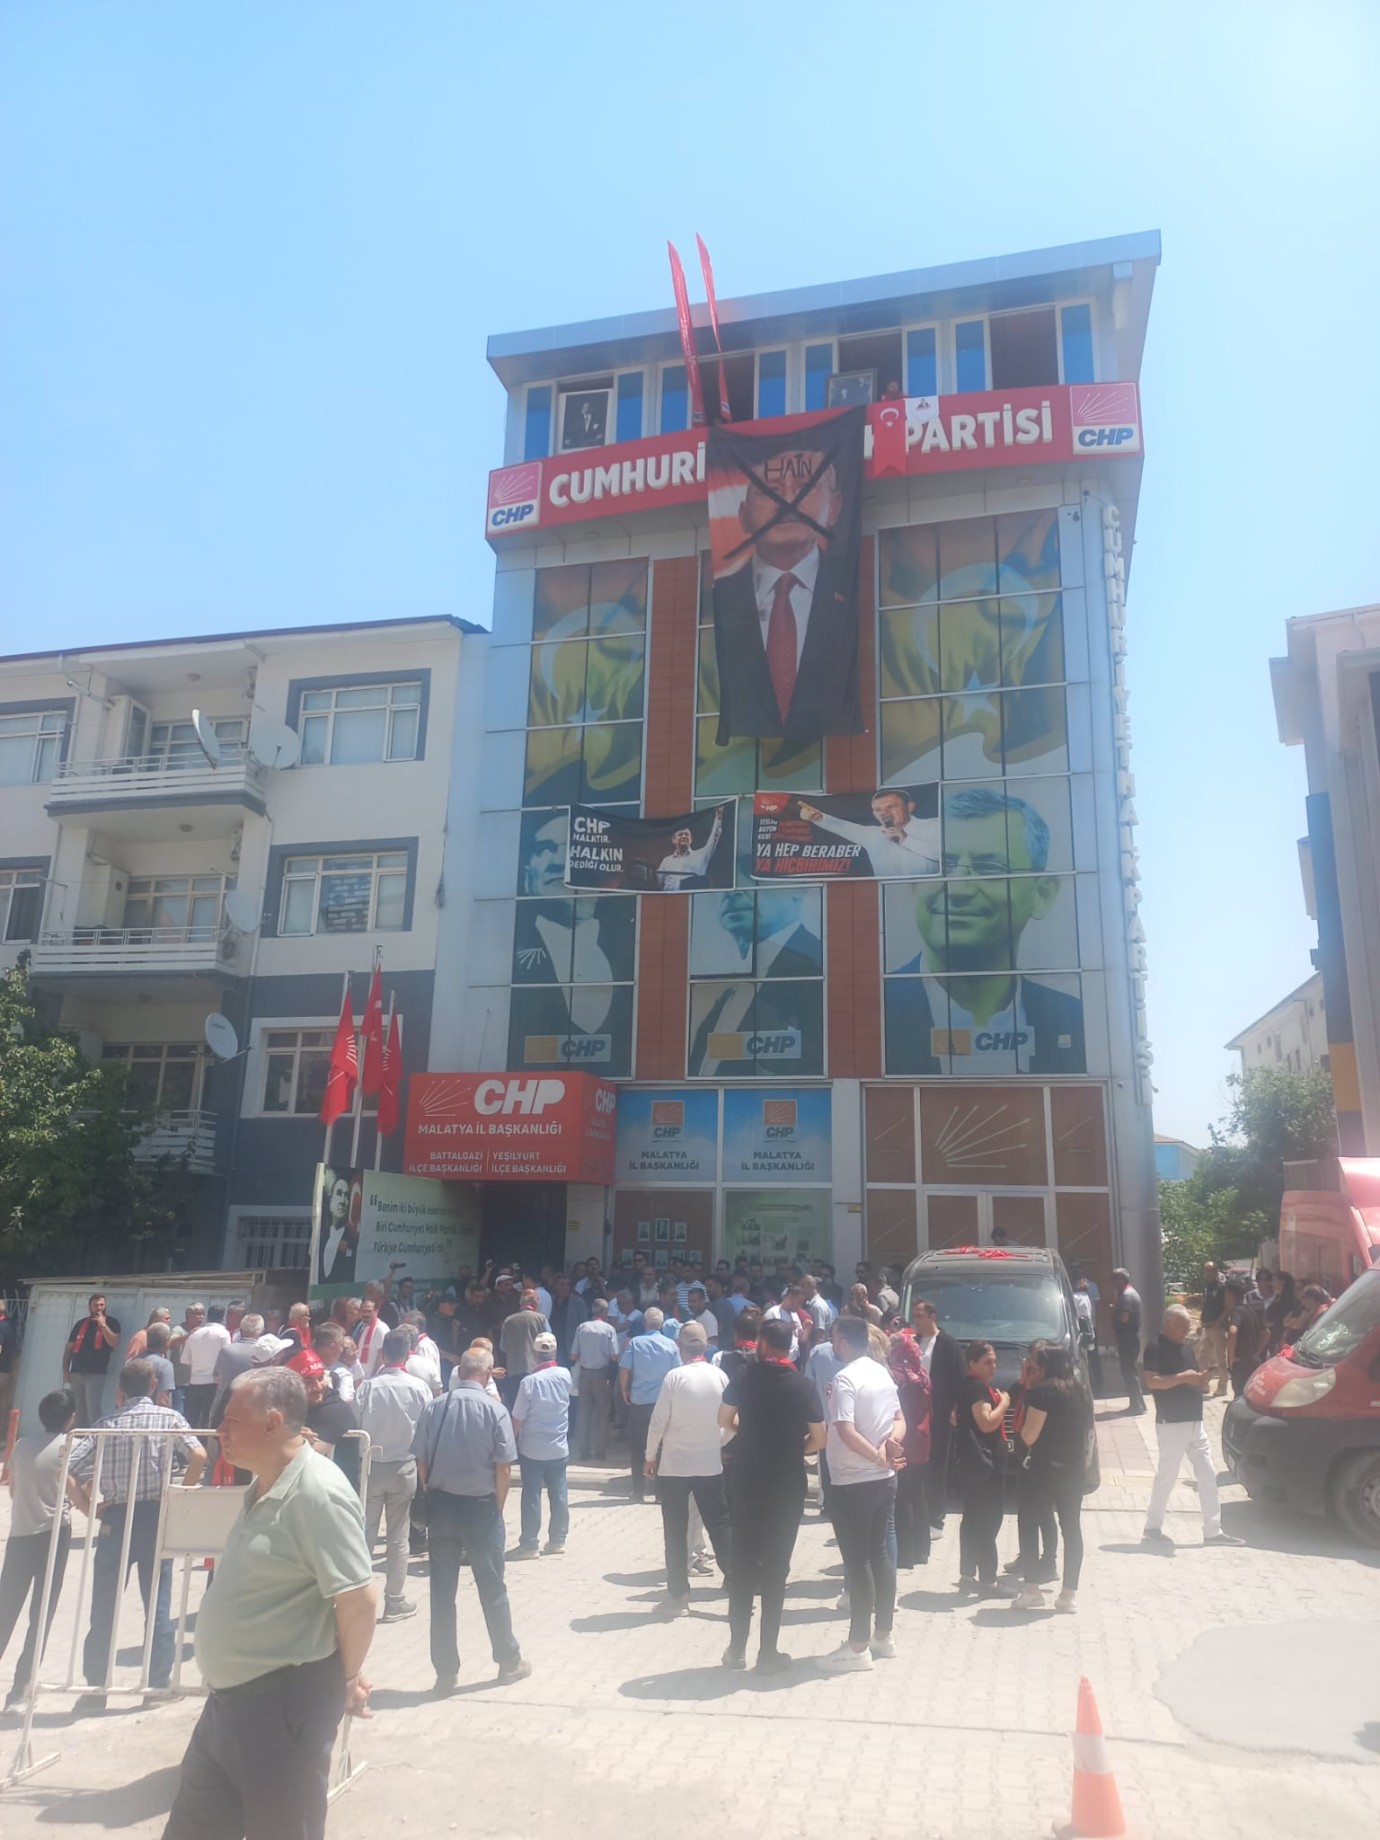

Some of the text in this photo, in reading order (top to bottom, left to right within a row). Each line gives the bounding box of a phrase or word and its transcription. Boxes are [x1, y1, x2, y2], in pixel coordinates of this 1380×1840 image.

[905, 401, 1053, 454] PARTİSİ
[1078, 427, 1134, 448] CHP
[491, 504, 534, 527] CHP
[574, 816, 611, 834] CHP
[570, 845, 623, 862] HALKIN
[757, 843, 861, 858] YA HEP BERABER
[599, 863, 624, 873] OLUR.
[755, 857, 772, 872] YA
[561, 1039, 606, 1057] CHP
[746, 1036, 796, 1054] CHP
[974, 1032, 1029, 1051] CHP
[474, 1079, 566, 1116] CHP
[595, 1088, 616, 1115] CHP
[418, 1121, 562, 1137] MALATYA İL BAŞKANLIĞI
[653, 1127, 681, 1138] CHP
[766, 1127, 794, 1138] CHP
[430, 1149, 483, 1160] BATTALGAZİ
[492, 1149, 541, 1162] YEŞİLYURT
[641, 1151, 688, 1160] MALATYA
[753, 1151, 802, 1160] MALATYA
[409, 1163, 482, 1175] İLÇE BAŞKANLIĞI
[491, 1163, 567, 1175] İLÇE BAŞKANLIĞI
[629, 1159, 699, 1171] İL BAŞKANLIĞI
[741, 1160, 815, 1172] İL BAŞKANLIĞI
